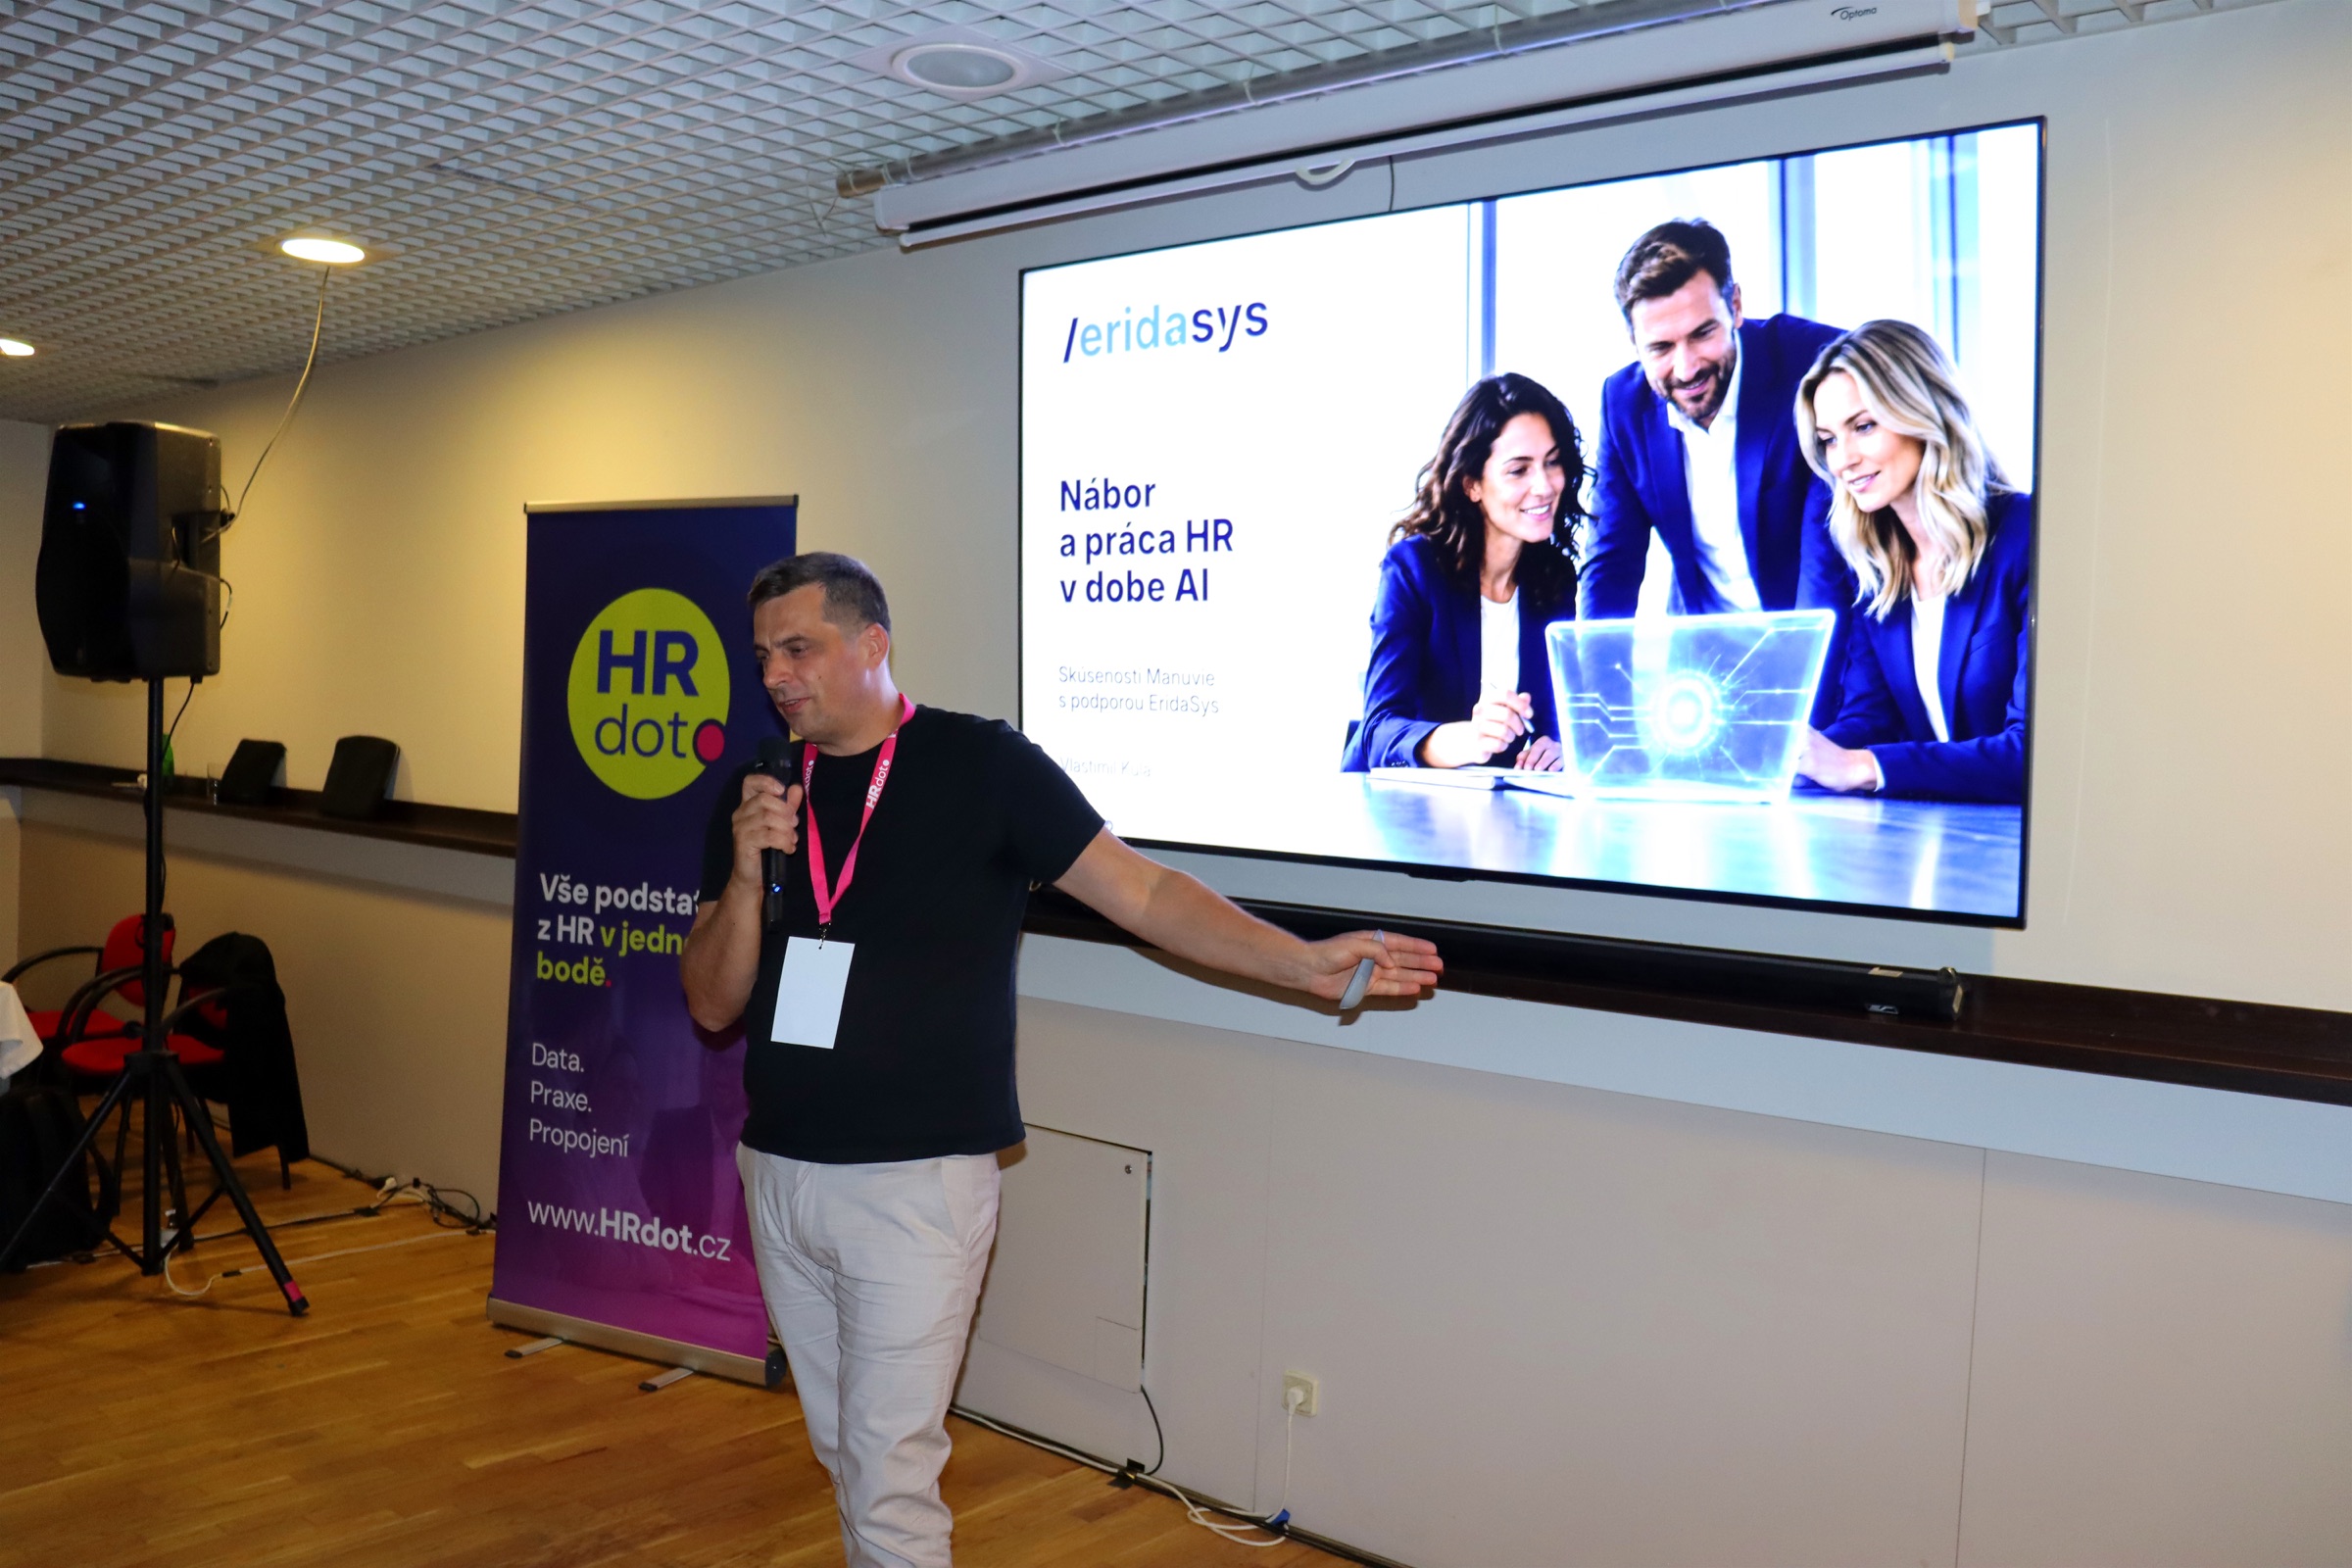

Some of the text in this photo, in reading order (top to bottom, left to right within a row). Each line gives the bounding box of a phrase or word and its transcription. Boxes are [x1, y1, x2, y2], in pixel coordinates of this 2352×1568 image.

[1840, 7, 1878, 21] Optoma
[1060, 477, 1156, 512] Nábor
[1059, 518, 1234, 564] a práca HR
[1059, 567, 1208, 603] v dobe AI
[597, 629, 700, 697] HR
[1058, 665, 1215, 686] Skúsenosti Manuvie
[1058, 693, 1219, 716] s podporou EridaSys
[540, 872, 588, 905] Vše
[538, 914, 688, 956] z HR v jedn
[532, 1042, 585, 1073] Data.
[530, 1080, 592, 1112] Praxe.
[529, 1118, 630, 1158] Propojení
[527, 1200, 731, 1261] www.HRdot.cz
